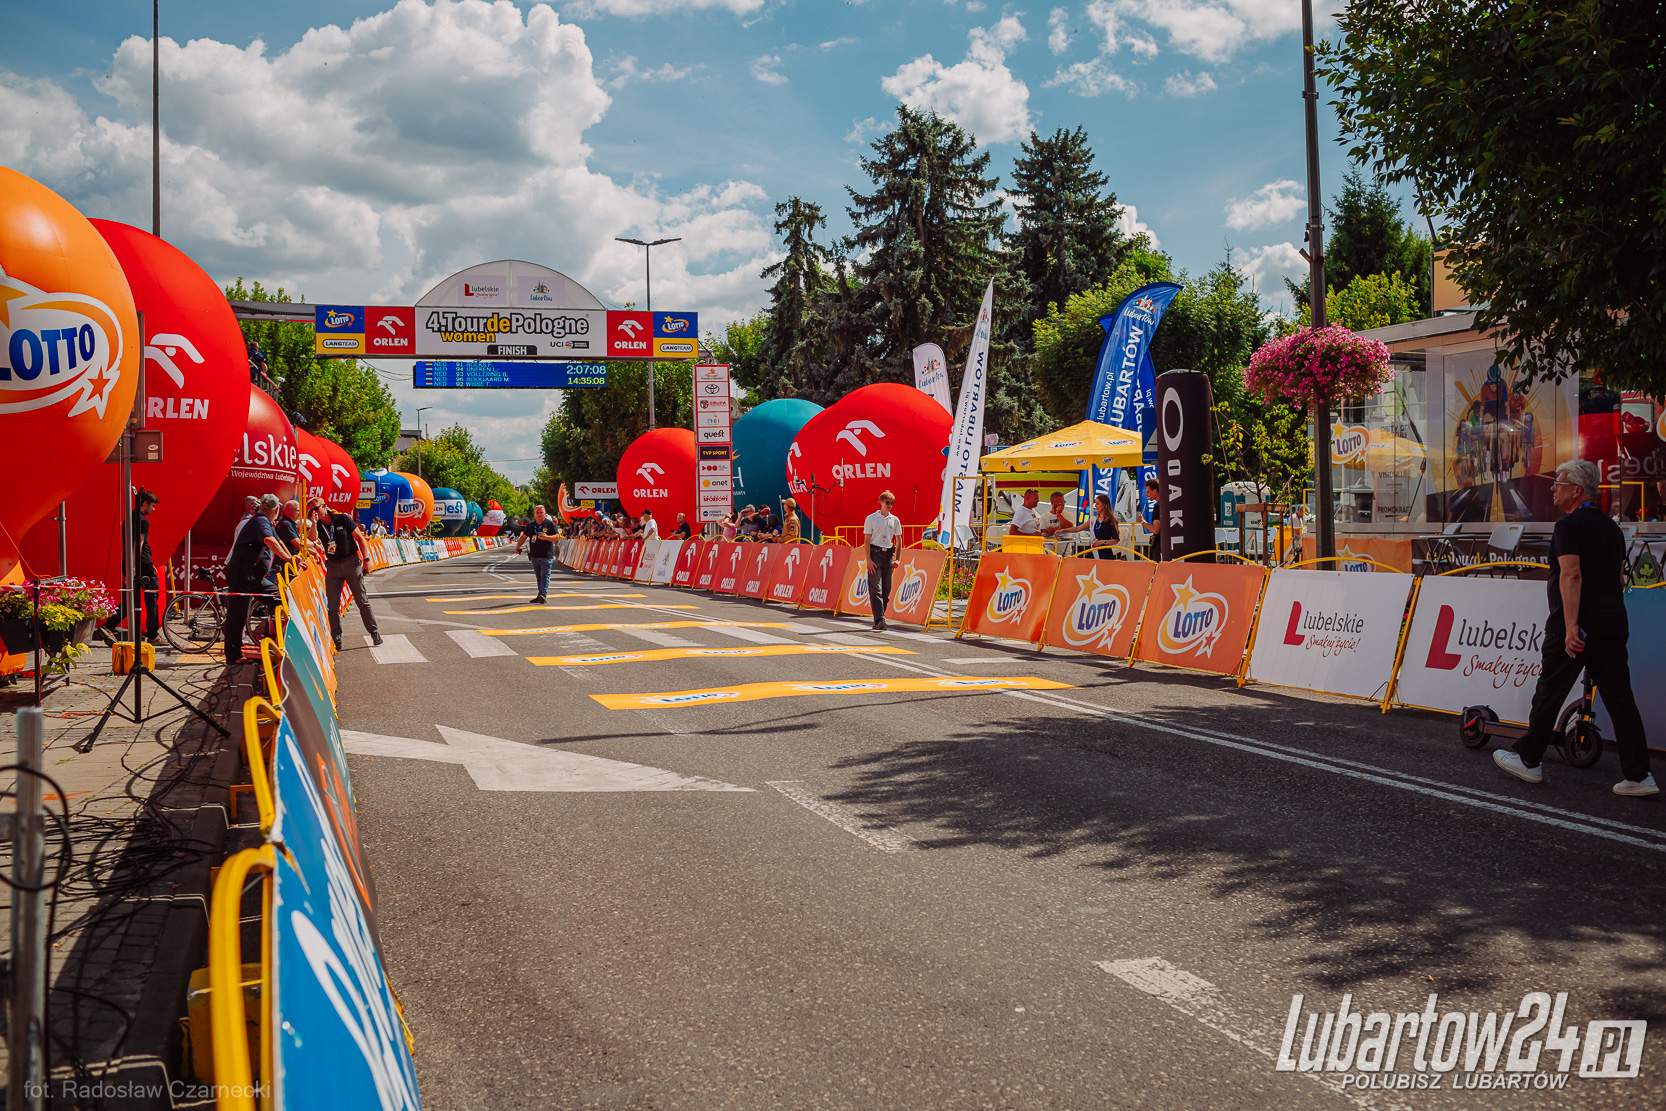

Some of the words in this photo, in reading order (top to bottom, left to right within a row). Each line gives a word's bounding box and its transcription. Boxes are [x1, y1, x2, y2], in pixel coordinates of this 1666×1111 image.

[330, 315, 350, 325] LOTTO
[1123, 306, 1155, 326] Lubartów
[667, 322, 685, 330] LOTTO
[373, 337, 408, 347] ORLEN
[497, 345, 528, 355] FINISH
[614, 341, 647, 349] ORLEN
[566, 364, 607, 374] 2:07:08
[1110, 325, 1144, 428] UBARTÓW
[567, 377, 605, 385] 14:35:08
[146, 397, 210, 421] RLEN
[703, 429, 725, 440] quest
[1336, 434, 1362, 454] LOTTO
[831, 463, 891, 480] ORLEN
[633, 488, 669, 498] ORLEN
[398, 503, 420, 514] LOTTO
[447, 503, 464, 514] est
[773, 584, 794, 598] ORLEN
[808, 587, 829, 603] ORLEN
[901, 581, 921, 602] LOTTO
[997, 589, 1022, 612] LOTTO
[1077, 599, 1116, 630] LOTTO
[1303, 610, 1364, 634] lubelskie
[1173, 607, 1213, 639] LOTTO
[1458, 616, 1546, 653] lubelsk
[1305, 634, 1335, 658] Smakuj
[1463, 655, 1514, 688] Smakuj
[1510, 656, 1544, 688] życ
